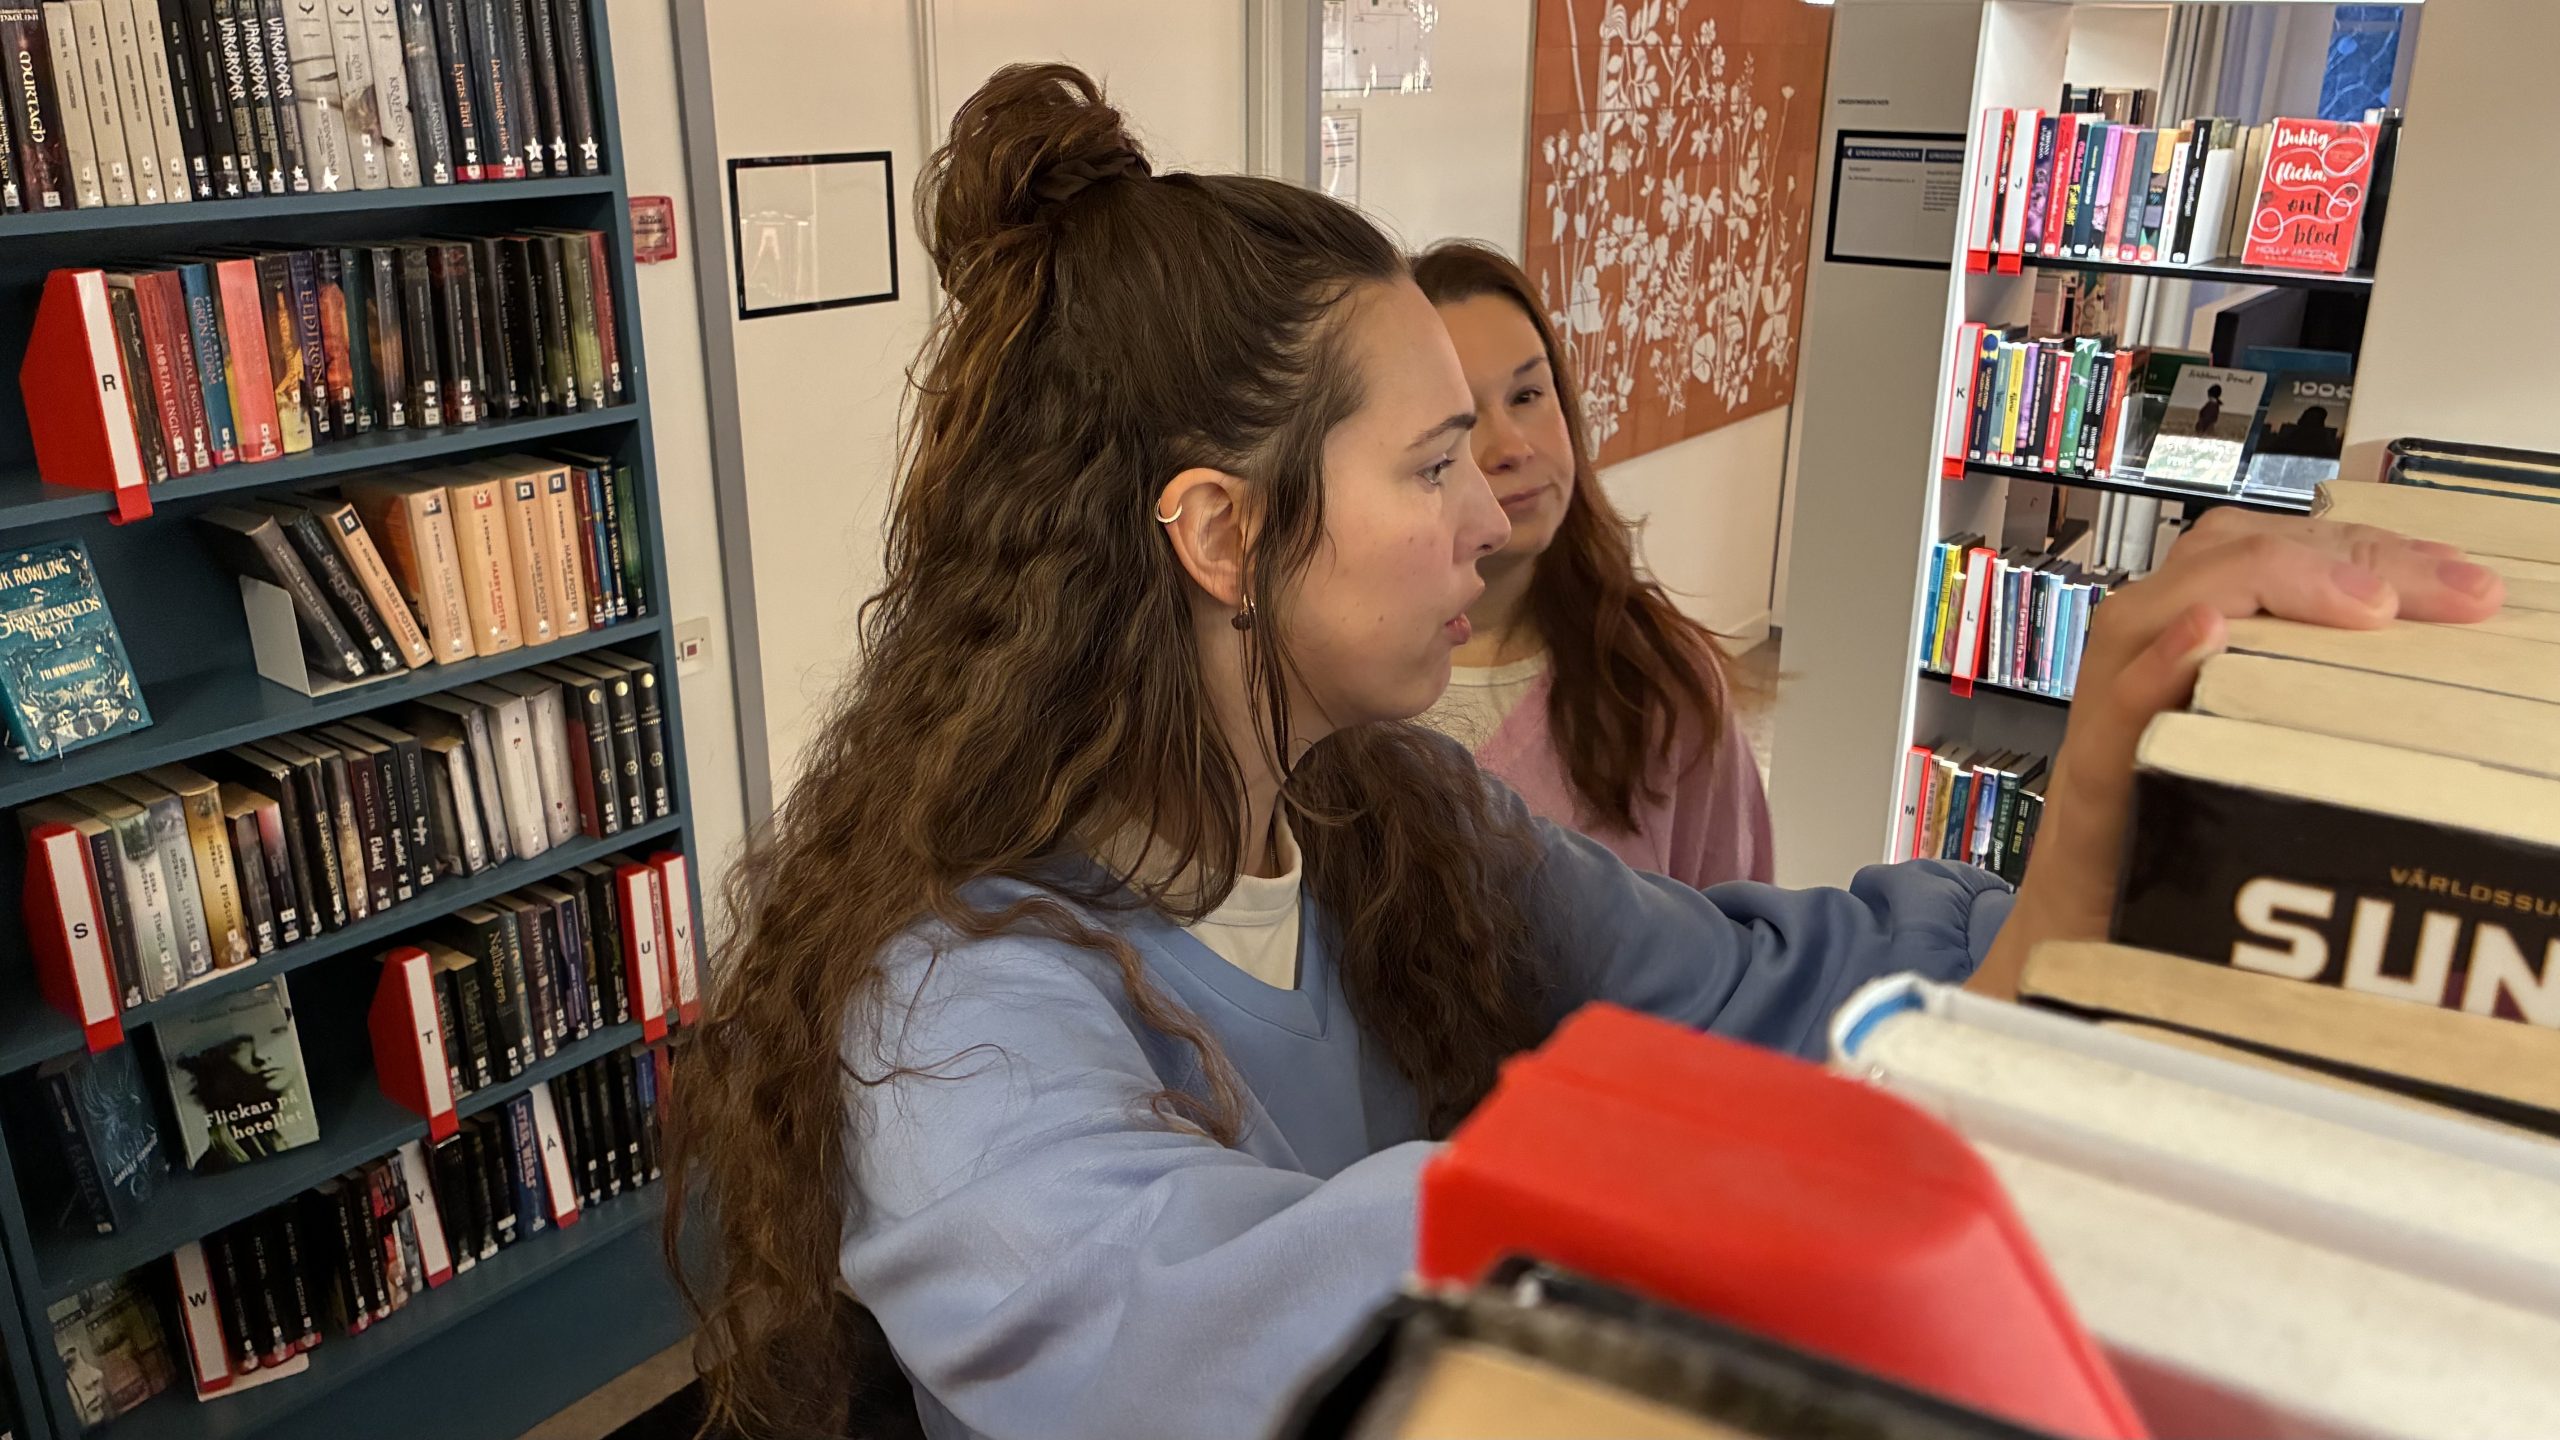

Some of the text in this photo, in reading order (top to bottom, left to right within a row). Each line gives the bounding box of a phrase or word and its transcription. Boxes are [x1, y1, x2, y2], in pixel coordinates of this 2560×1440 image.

[217, 17, 246, 101] VARGBRÖDER
[241, 17, 269, 101] VARGBRÖDER
[267, 17, 293, 99] VARGBRÖDER
[389, 76, 406, 134] KRAFTEN
[2277, 127, 2329, 150] Duktig
[1855, 150, 1920, 159] UNGDOMSBÖCKER
[2014, 176, 2023, 190] J
[2275, 162, 2327, 185] flicka,
[2287, 192, 2320, 215] ont
[2294, 224, 2339, 246] blod
[2256, 245, 2288, 254] HOLLY
[194, 297, 218, 385] GRÖN STORM
[180, 333, 191, 380] MORTAL
[102, 374, 117, 391] R
[155, 343, 181, 438] MORTAL ENGIN
[1956, 388, 1965, 398] K
[13, 558, 71, 586] ROWLING
[564, 544, 581, 612] HARRY POTTER
[492, 560, 508, 631] HARRY POTTER
[1967, 611, 1974, 622] L
[28, 619, 75, 642] BROTT
[361, 771, 377, 831] CAMILLA STEN
[383, 764, 398, 822] CAMILLA STEN
[412, 790, 421, 811] STEN
[1905, 805, 1915, 816] M
[2391, 866, 2560, 916] VÄRLDSSU
[73, 923, 89, 939] S
[153, 912, 168, 952] TIMGLA
[676, 925, 687, 940] V
[641, 941, 651, 955] U
[422, 1030, 434, 1044] T
[204, 1089, 300, 1128] Flickan på
[231, 1110, 304, 1140] hotellet
[516, 1103, 537, 1189] STAR WARS
[415, 1191, 425, 1204] Y
[188, 1291, 207, 1308] W
